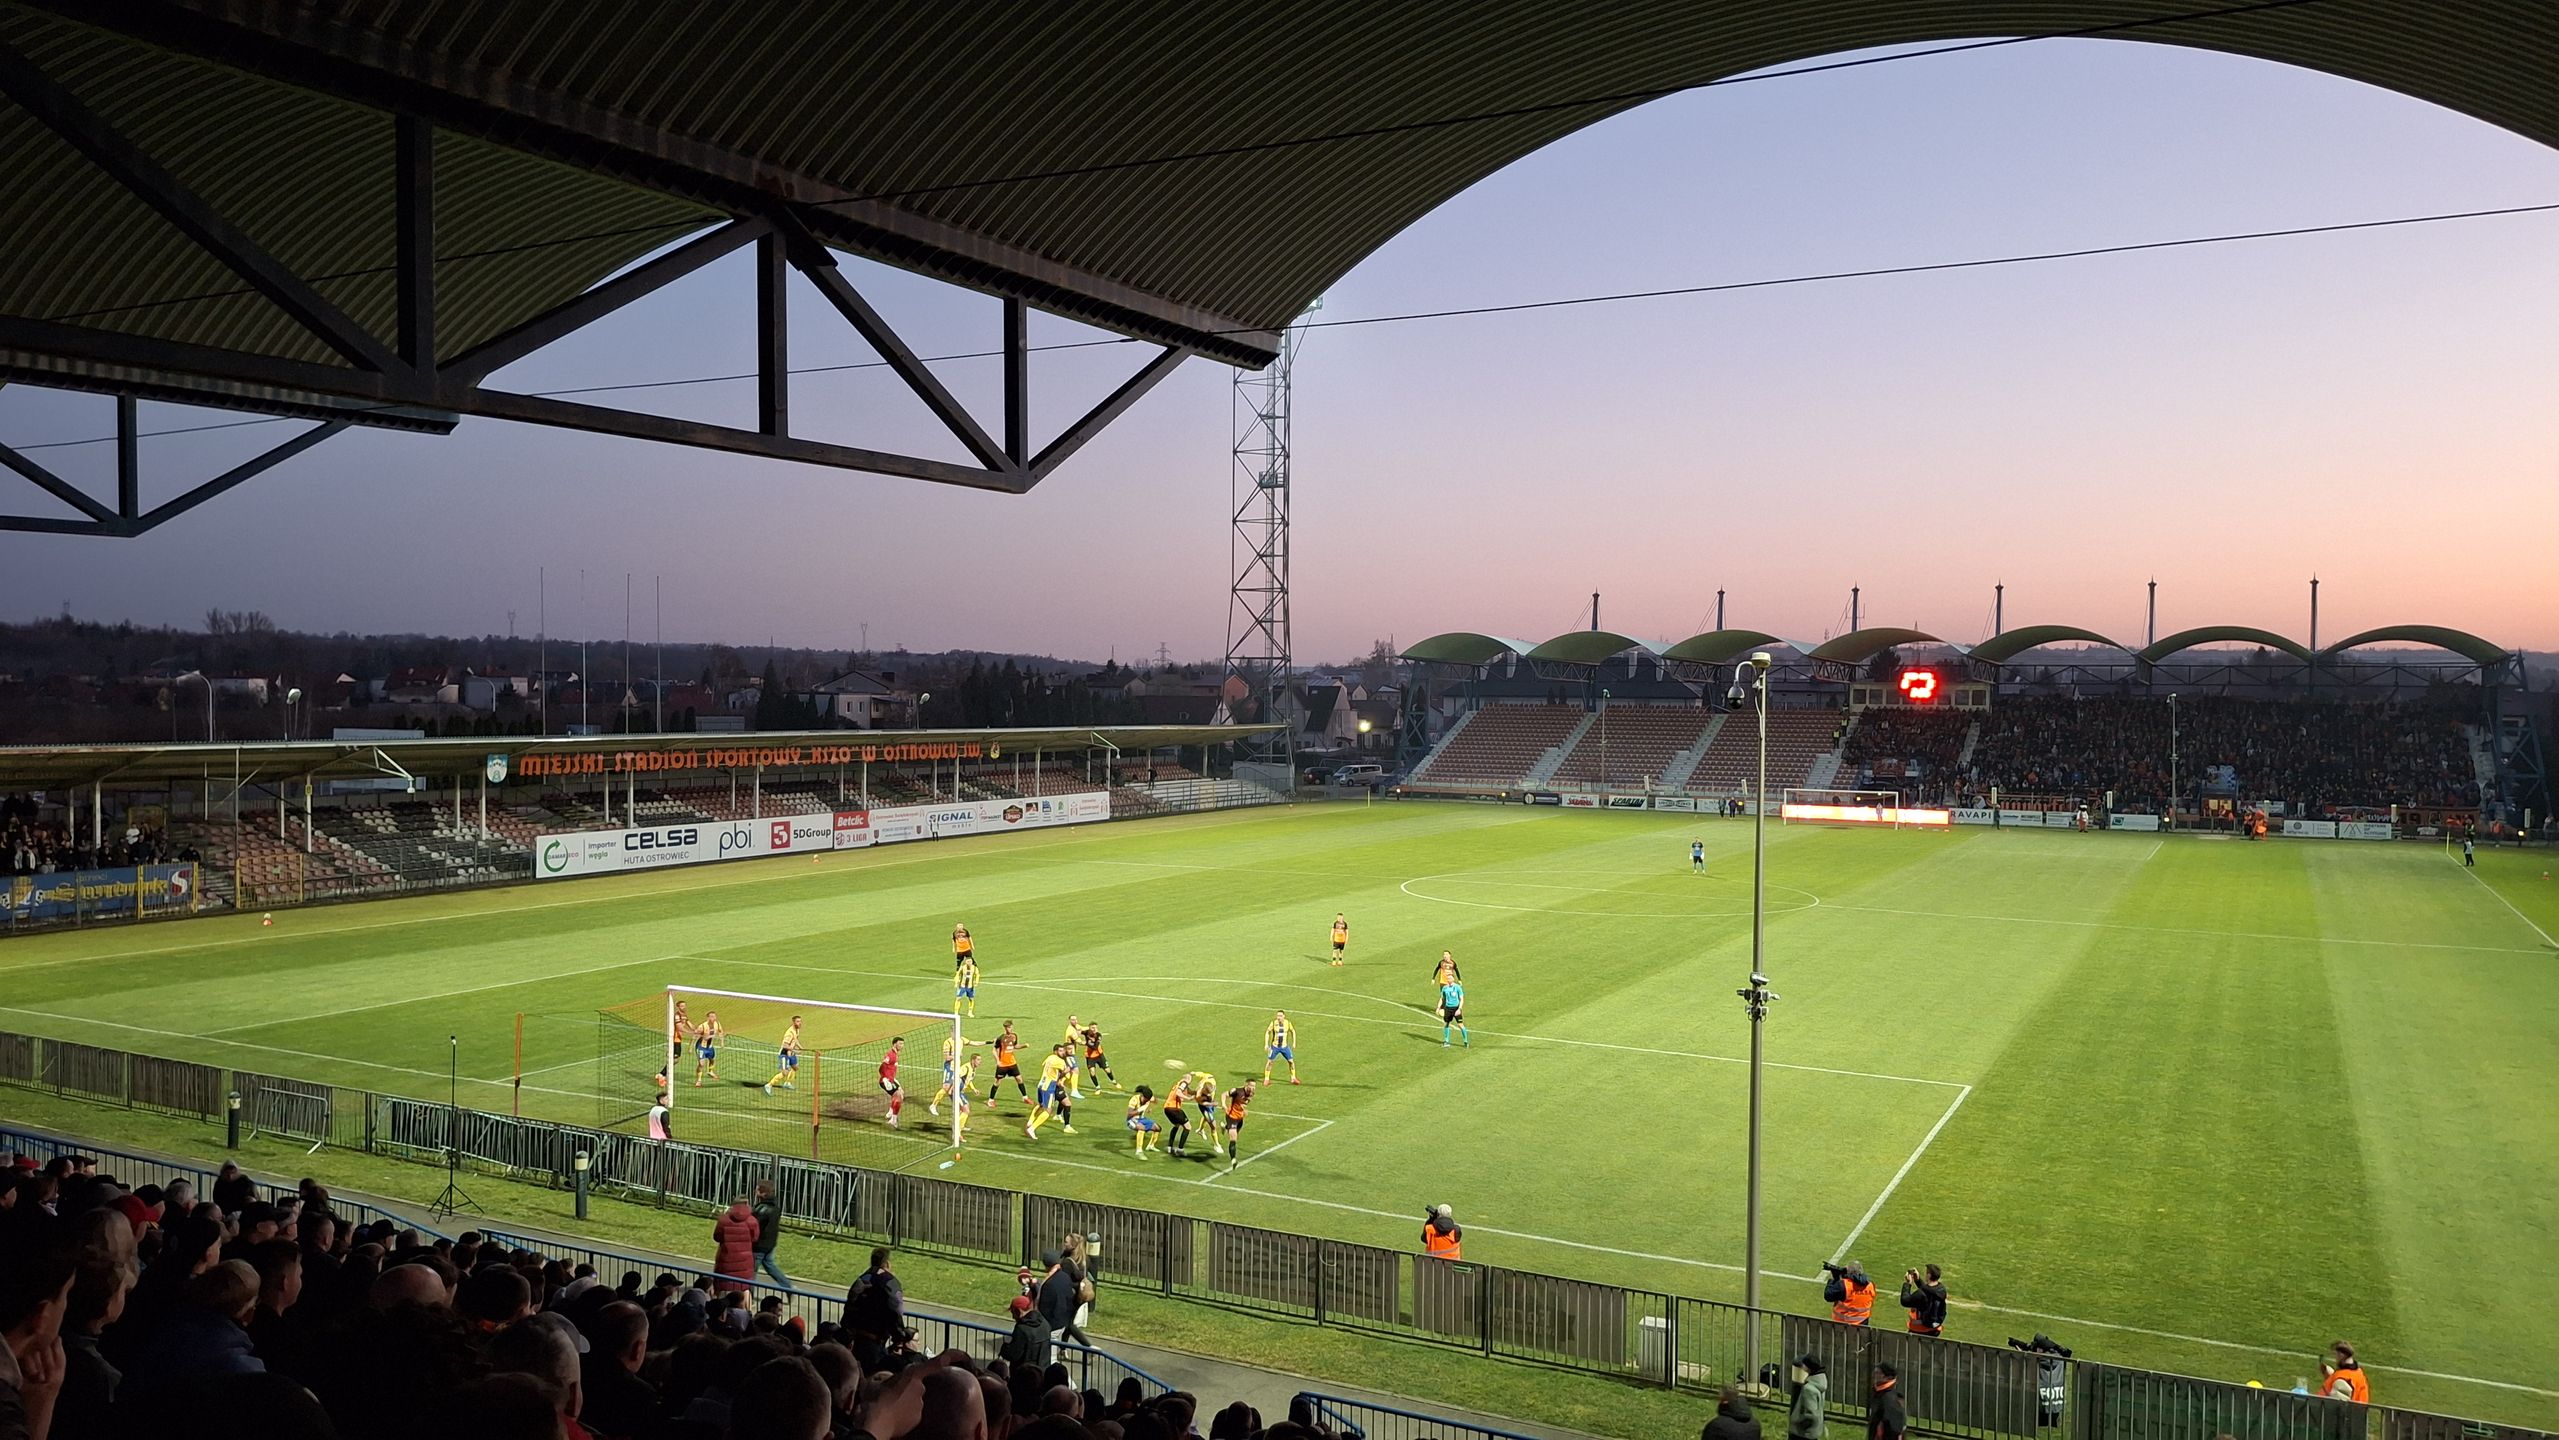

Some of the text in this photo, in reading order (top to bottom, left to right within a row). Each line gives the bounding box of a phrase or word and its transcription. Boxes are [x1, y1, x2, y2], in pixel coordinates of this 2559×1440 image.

[519, 753, 604, 776] MIEJSKI
[614, 750, 698, 772] STADION
[706, 747, 800, 768] SPORTOWY
[861, 745, 876, 762] W
[837, 815, 864, 827] Betclic
[929, 811, 974, 823] SIGNAL
[793, 828, 832, 839] 5DGroup
[624, 851, 690, 865] HUTA OSTROWIEC
